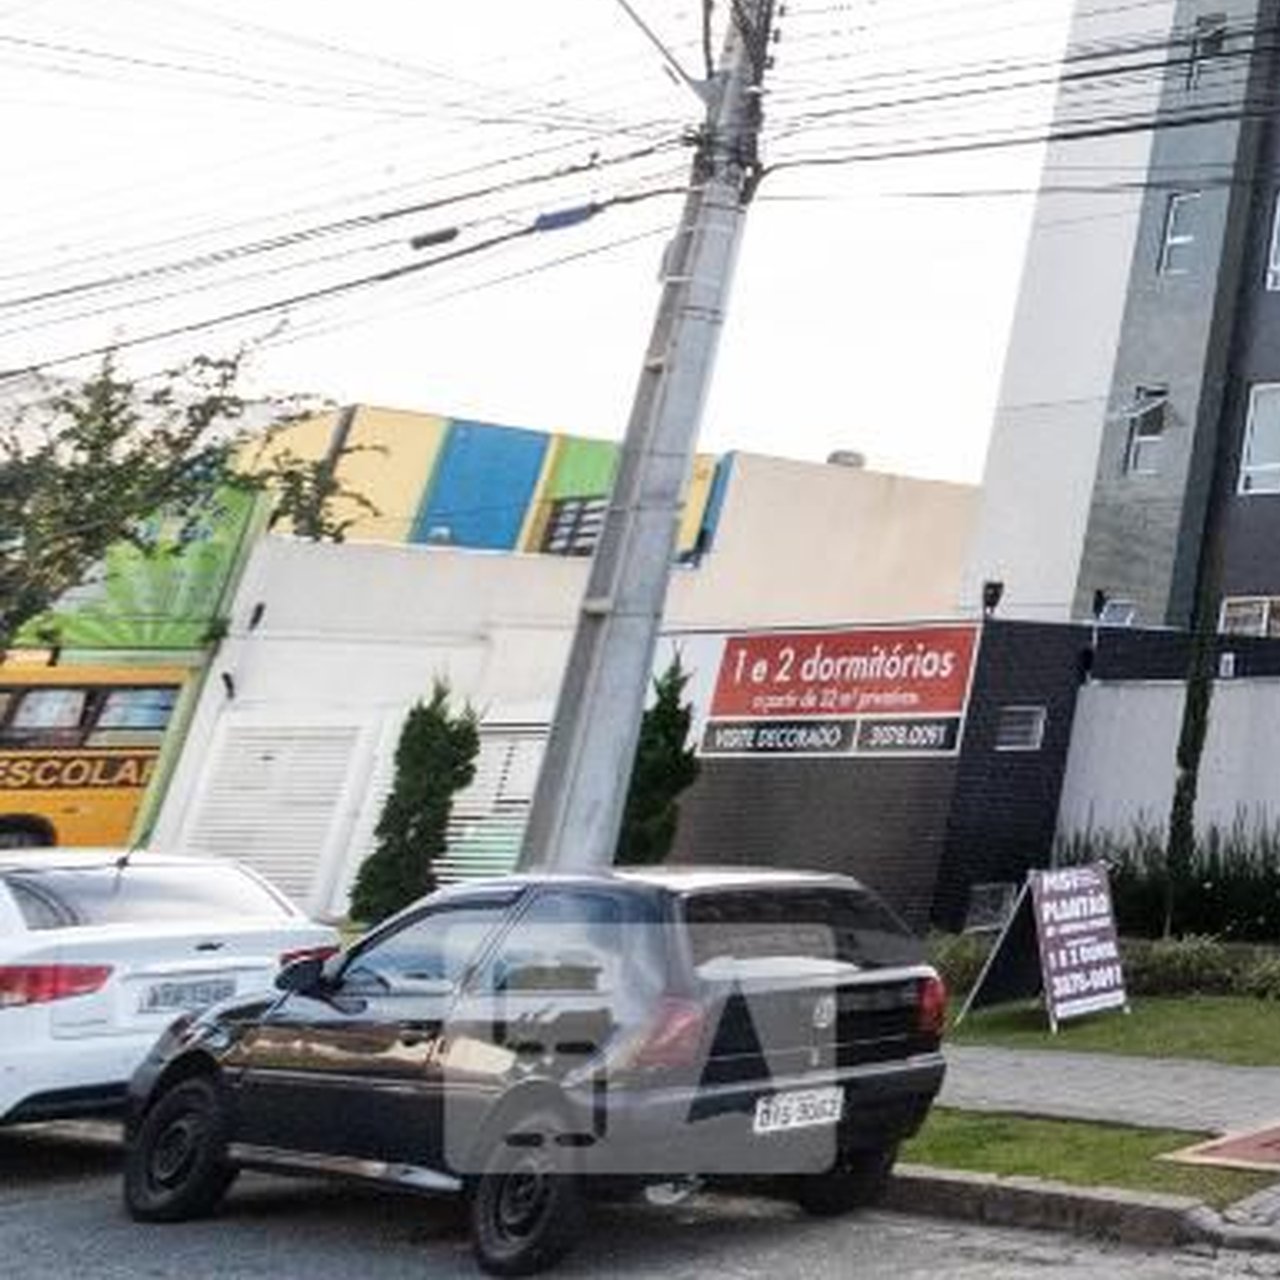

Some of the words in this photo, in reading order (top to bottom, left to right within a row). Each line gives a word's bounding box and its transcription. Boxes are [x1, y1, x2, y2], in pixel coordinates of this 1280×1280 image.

[735, 648, 748, 683] 1
[751, 658, 768, 682] e
[775, 646, 795, 682] 2
[800, 639, 956, 682] dormitórios
[757, 725, 842, 748] DECORADO
